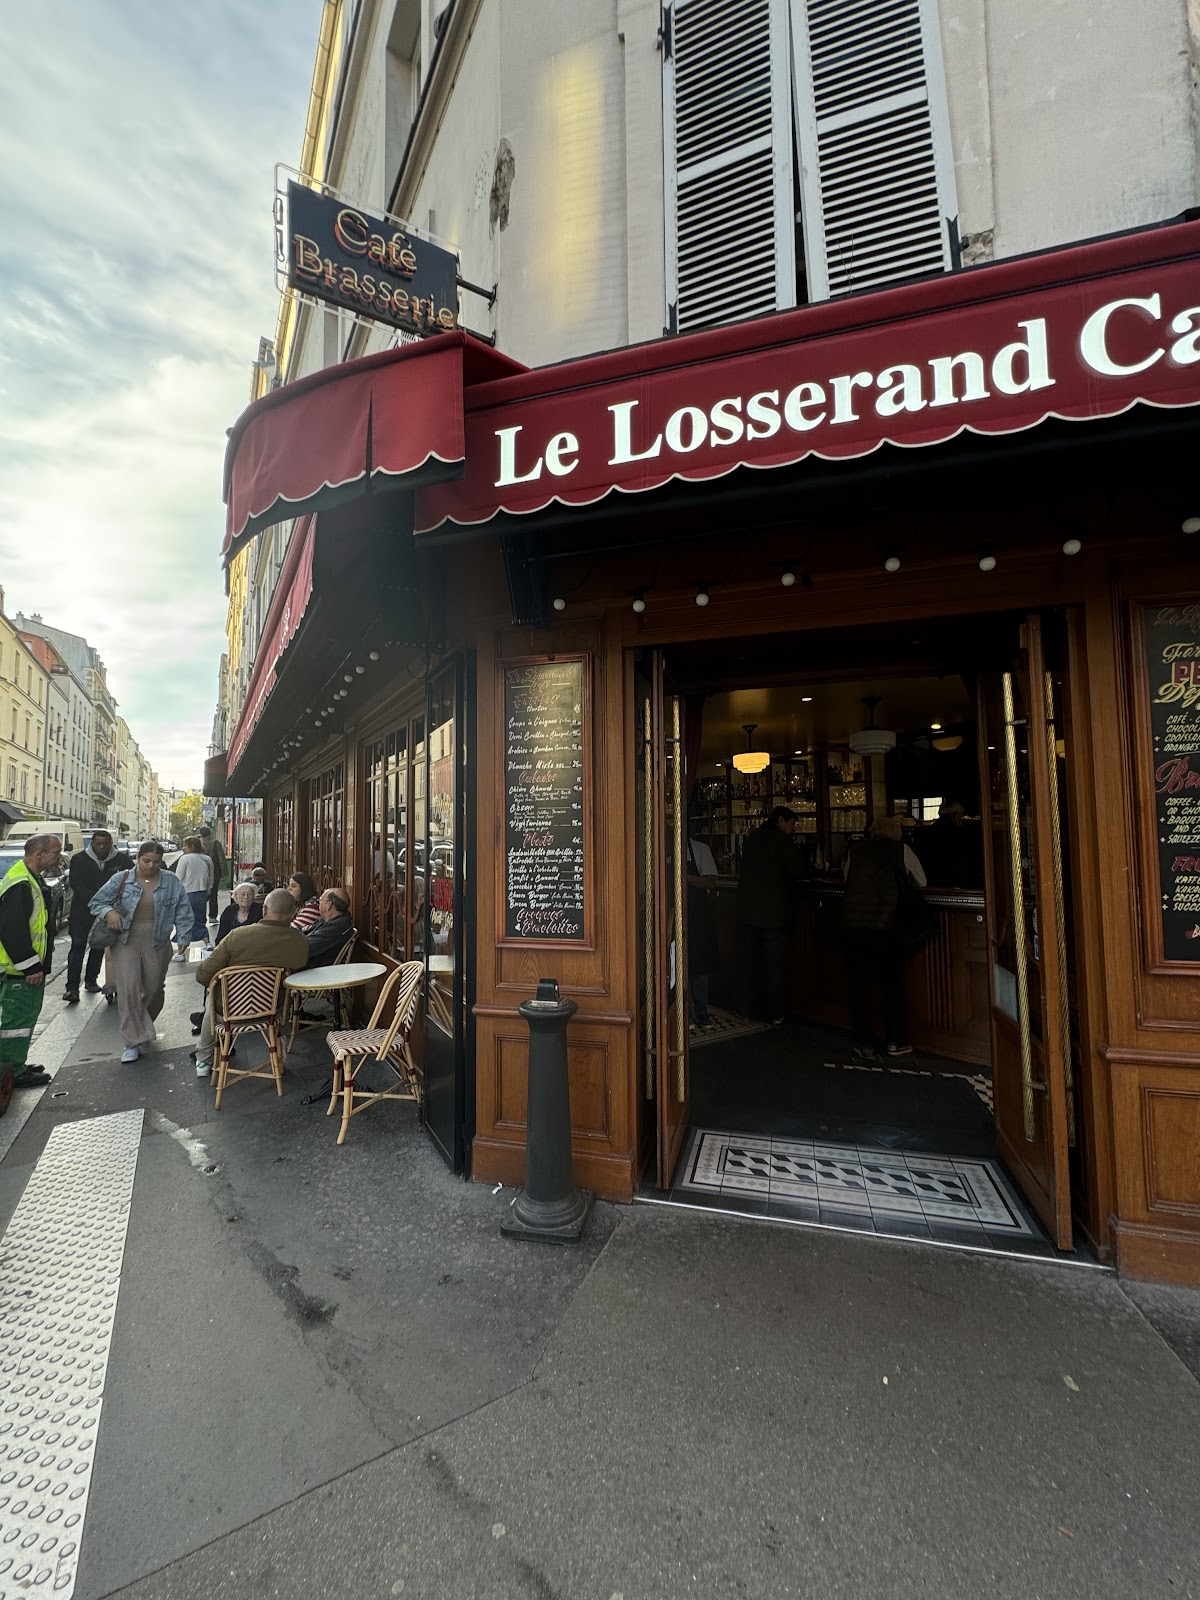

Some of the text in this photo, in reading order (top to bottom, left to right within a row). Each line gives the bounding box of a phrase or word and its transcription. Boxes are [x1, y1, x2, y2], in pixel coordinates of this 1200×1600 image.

[335, 209, 417, 276] Café
[294, 234, 455, 331] Brasserie
[494, 425, 580, 488] Le
[608, 317, 1056, 466] Losserand
[1166, 711, 1189, 725] CAFÉ
[1165, 797, 1193, 806] COFFEE
[1167, 807, 1178, 815] OR
[1173, 825, 1189, 833] AND
[528, 890, 549, 901] Burger
[529, 899, 551, 910] Burger
